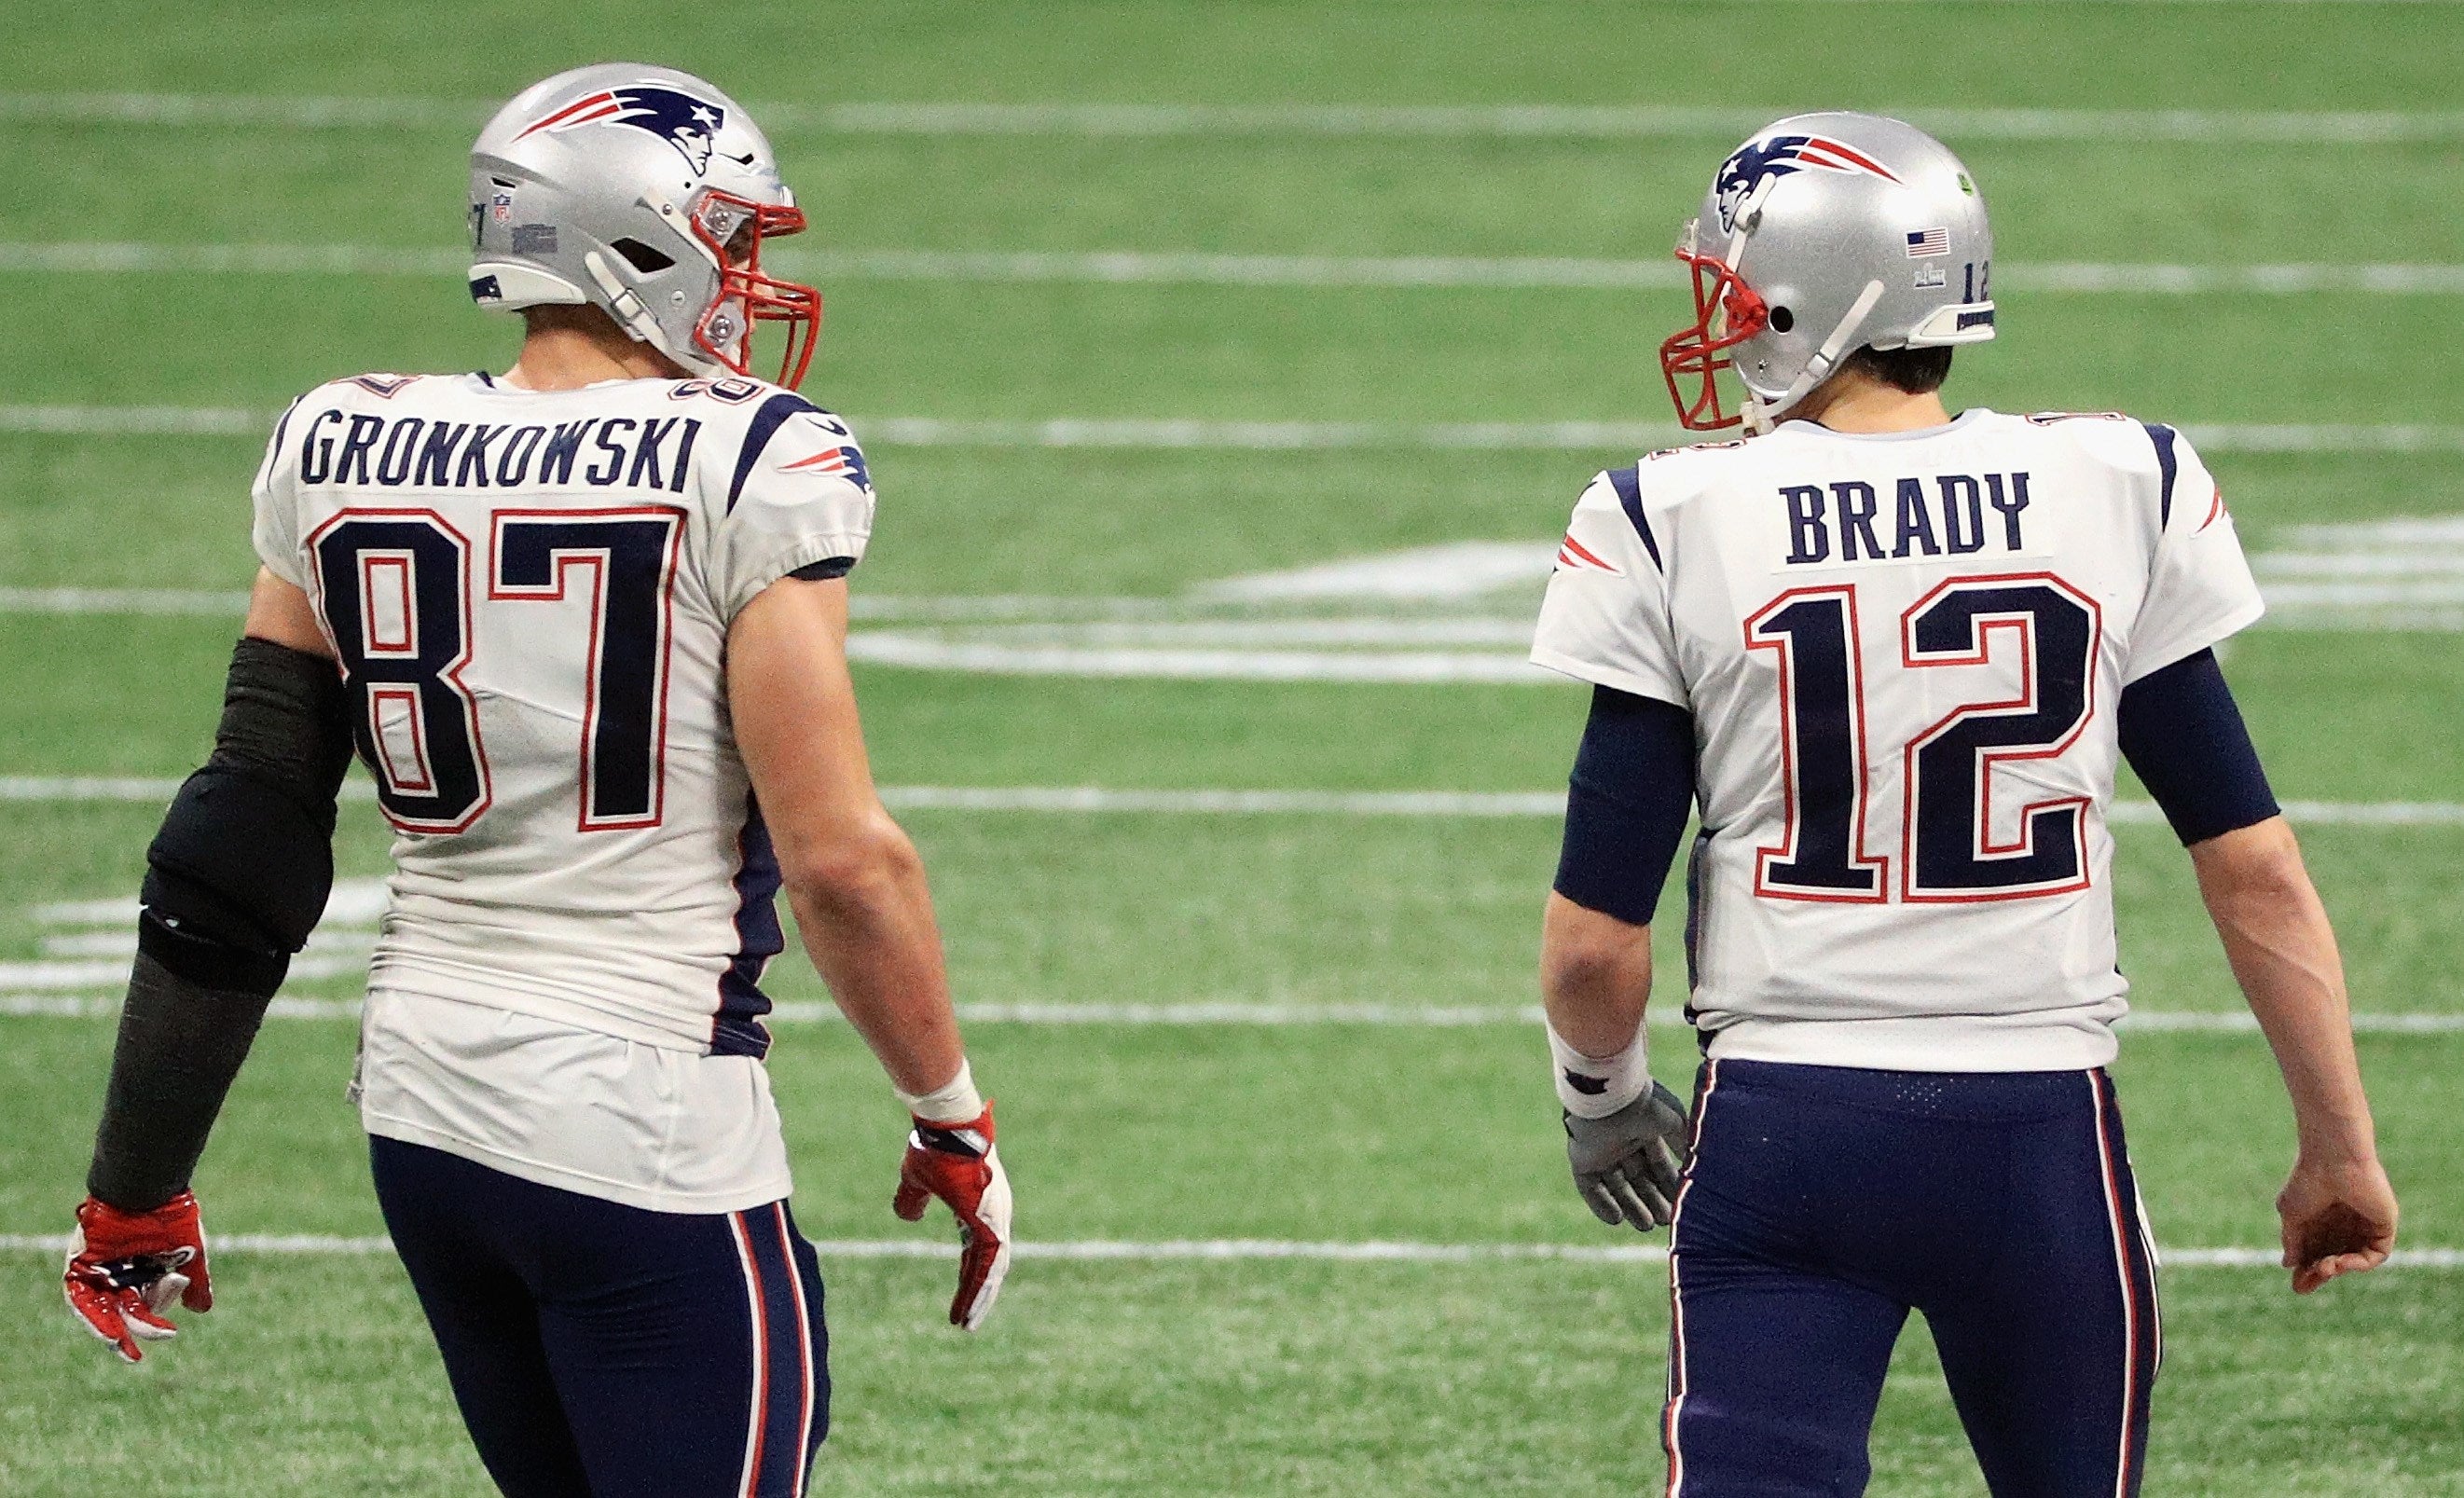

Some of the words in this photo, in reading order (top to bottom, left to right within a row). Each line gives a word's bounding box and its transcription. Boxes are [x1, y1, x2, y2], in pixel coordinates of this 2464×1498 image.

[300, 409, 700, 492] GRONKOWSKI
[1779, 472, 2030, 564] BRADY
[309, 507, 688, 834] 87
[1744, 570, 2101, 903] 12
